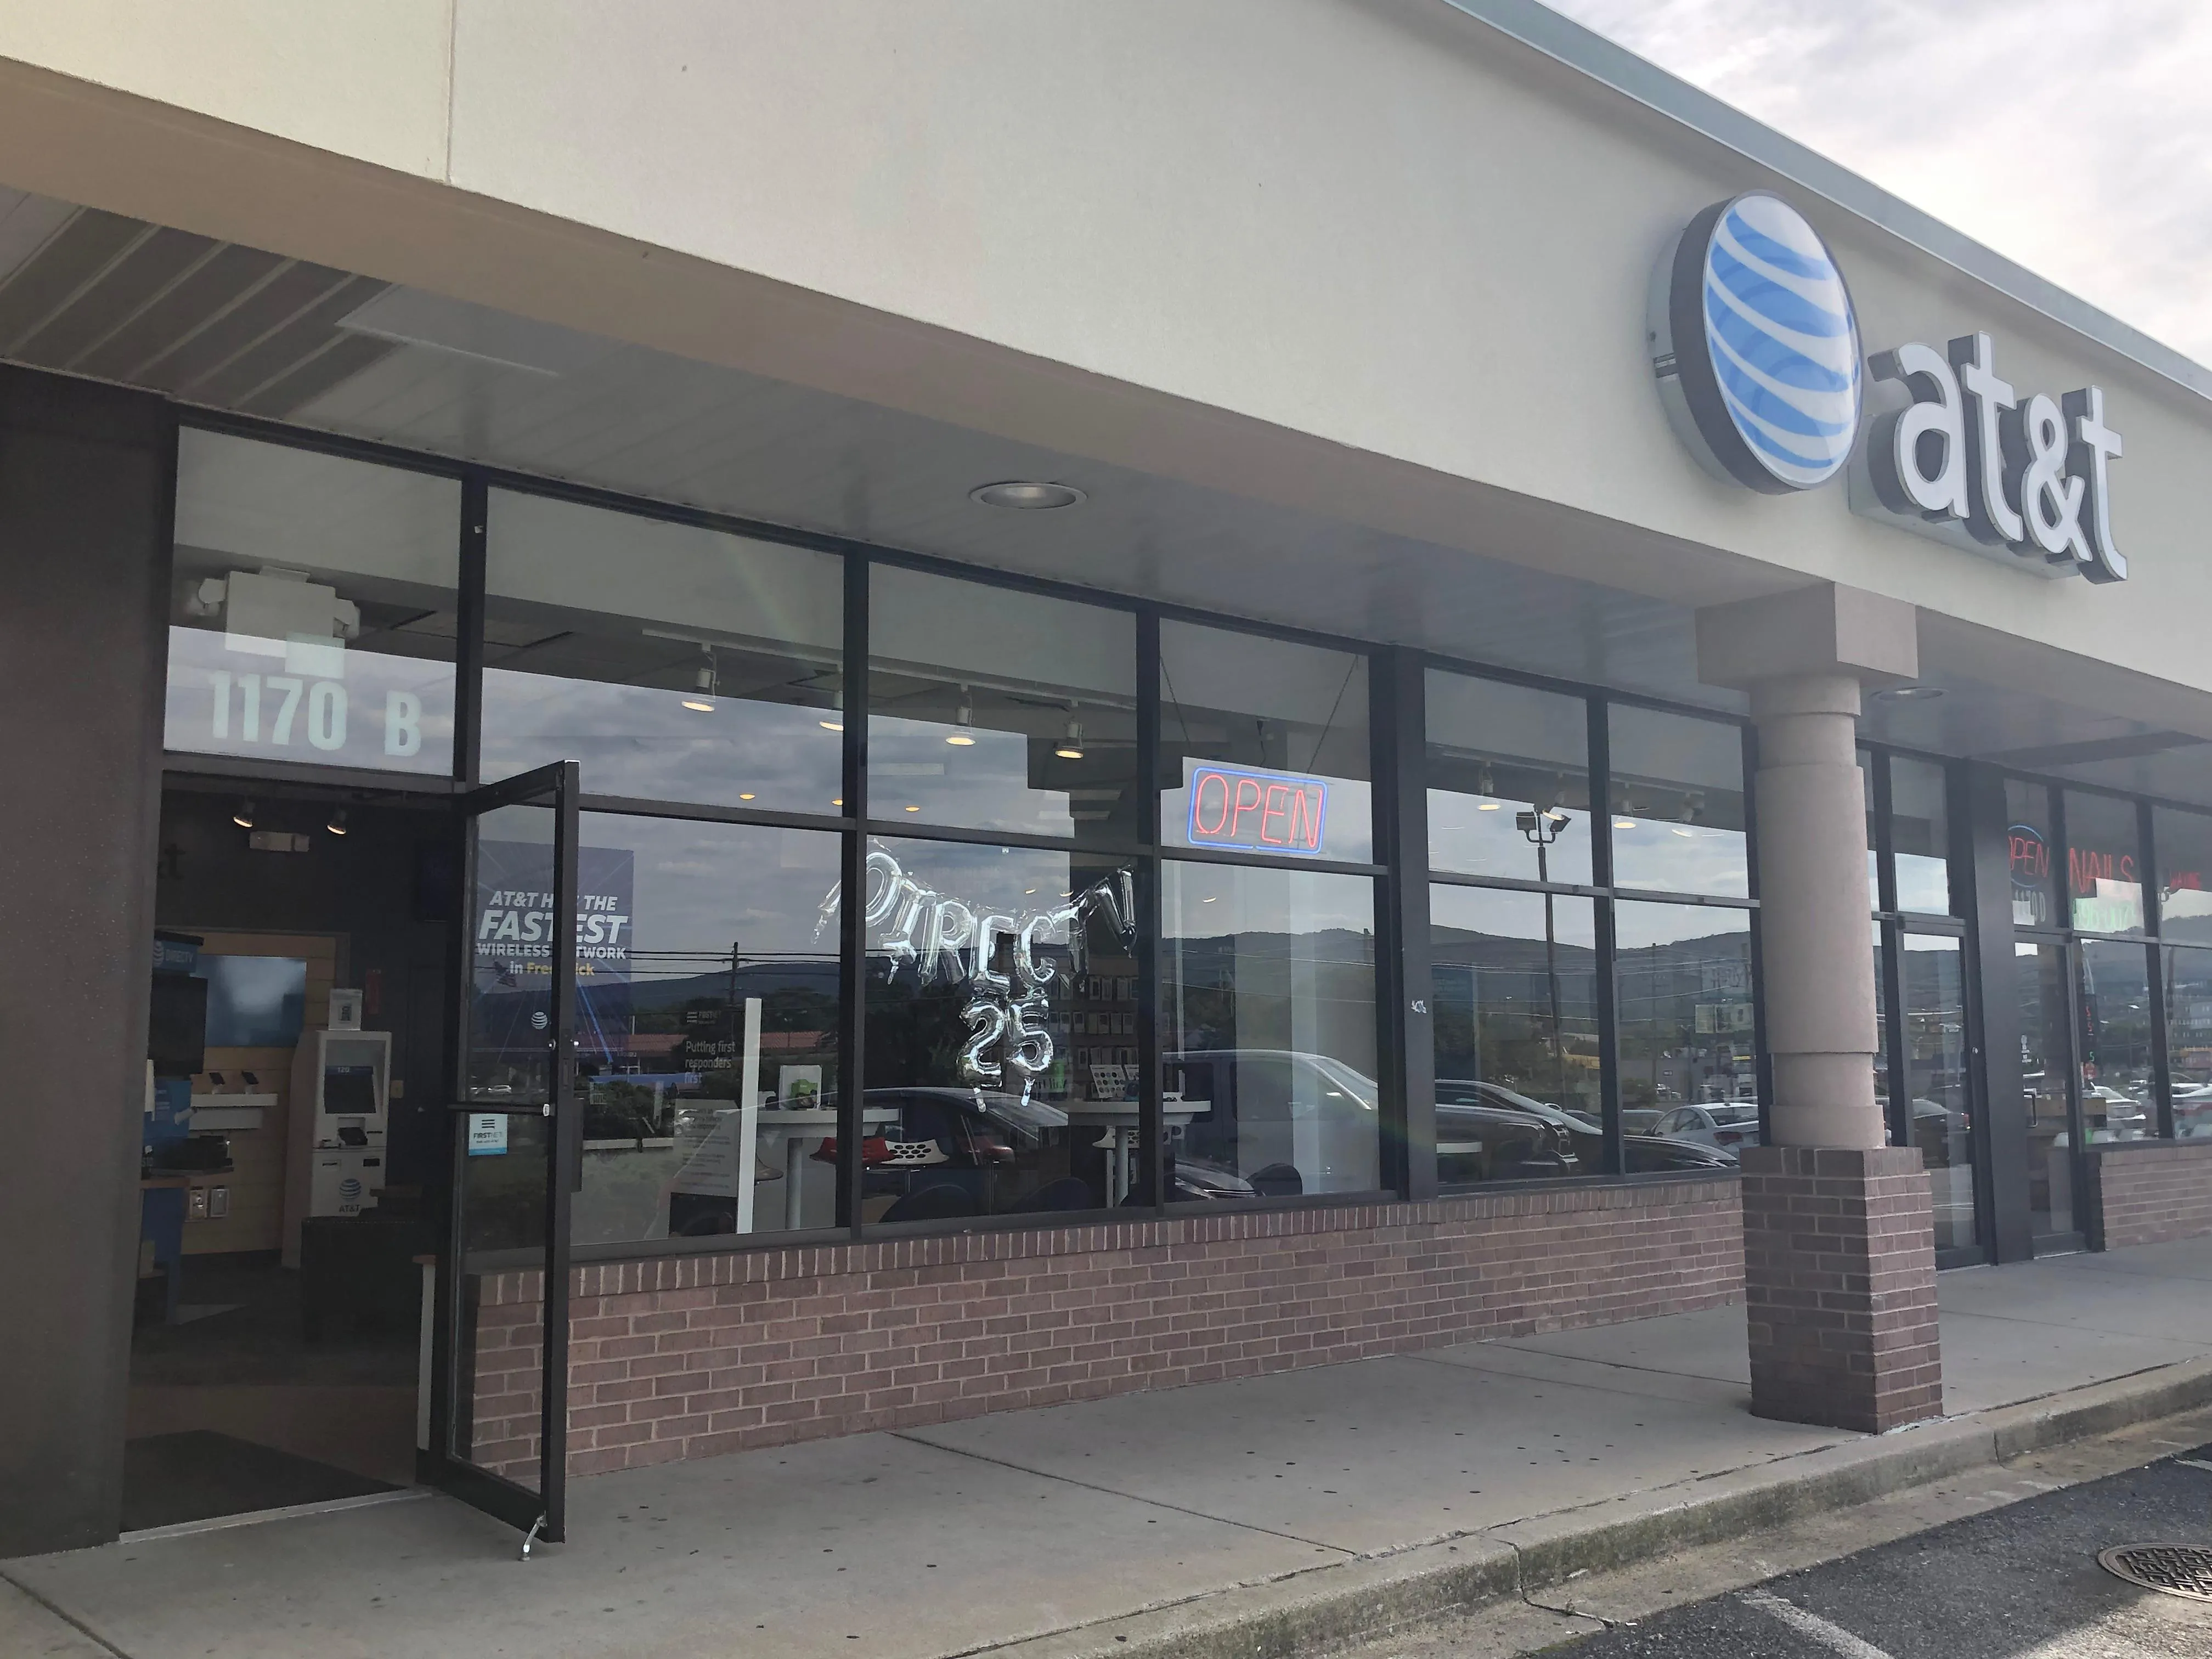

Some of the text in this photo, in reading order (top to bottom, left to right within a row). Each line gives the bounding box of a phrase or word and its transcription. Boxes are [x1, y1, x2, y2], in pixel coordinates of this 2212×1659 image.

[1891, 330, 2129, 583] at&t
[209, 670, 422, 757] 1170 B
[1195, 774, 1323, 848] OPEN
[2008, 836, 2050, 878] PEN
[489, 890, 539, 907] AT&T
[584, 895, 618, 911] THE
[477, 943, 627, 960] WIRELESS TWORK
[510, 961, 595, 976] in Freick
[686, 1041, 736, 1054] Putting first
[957, 995, 1053, 1087] 25
[685, 1057, 732, 1070] responders
[684, 1071, 702, 1084] first
[339, 1204, 360, 1212] AT&T
